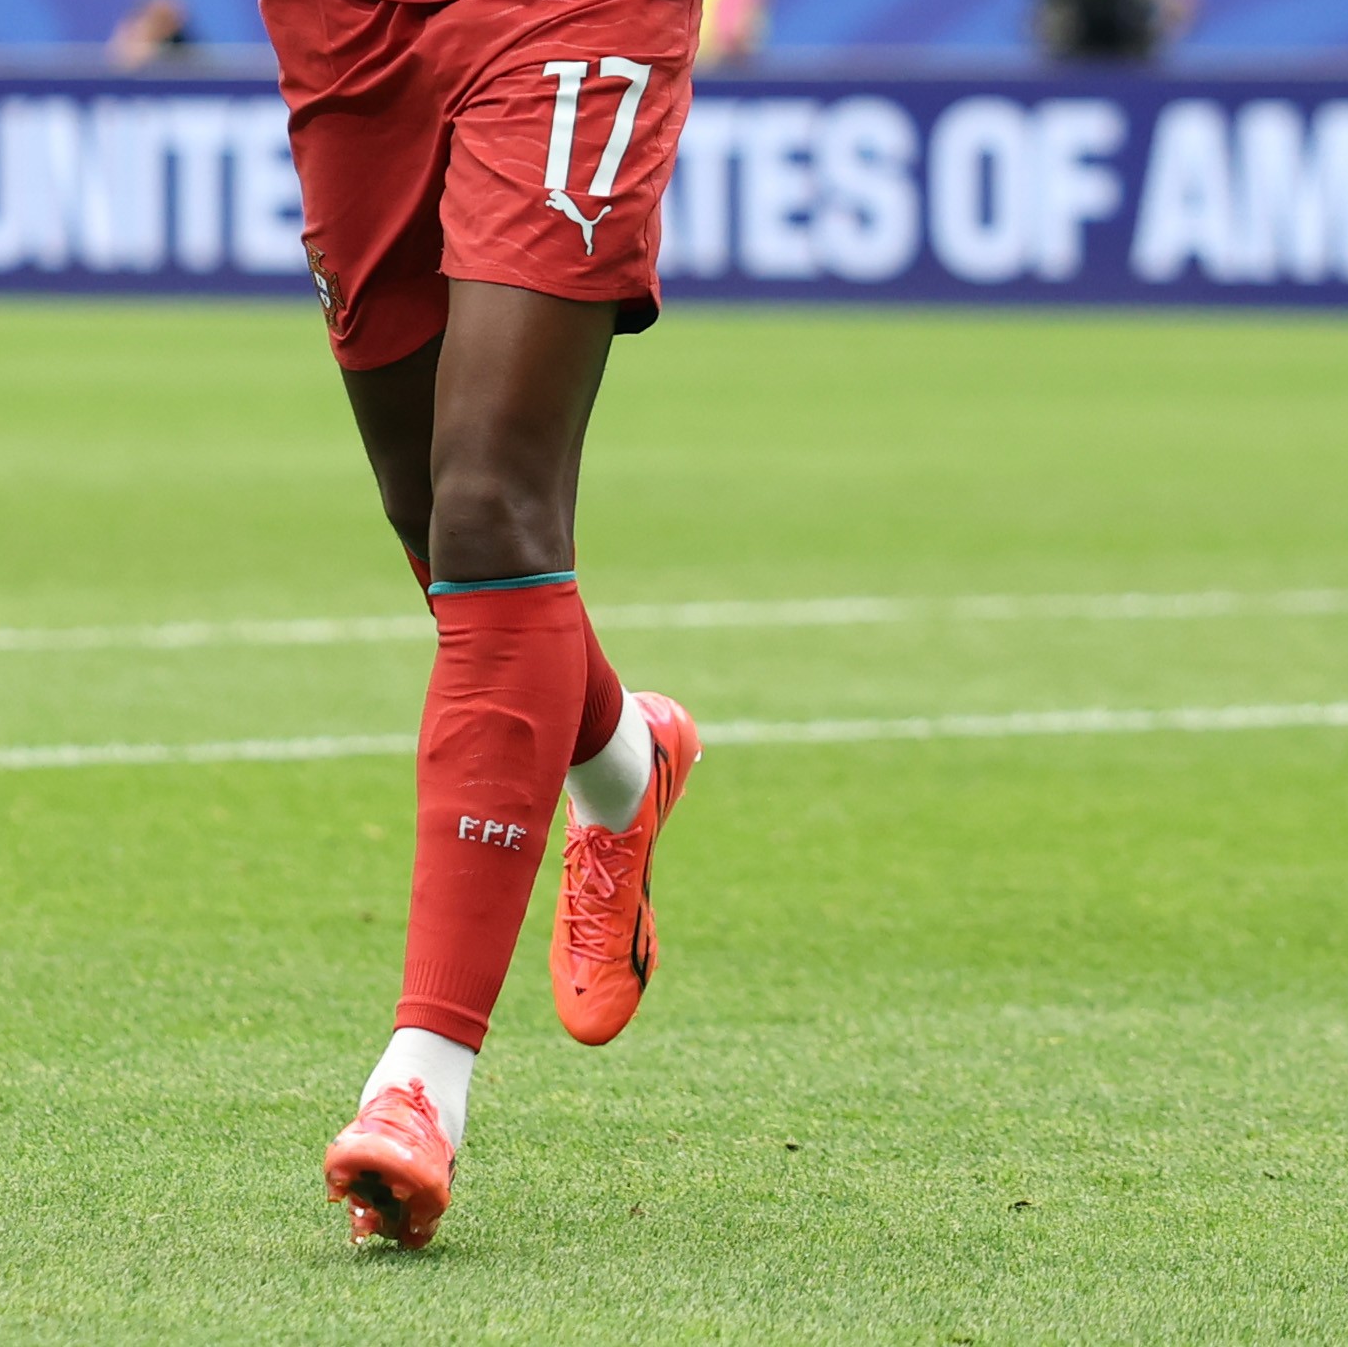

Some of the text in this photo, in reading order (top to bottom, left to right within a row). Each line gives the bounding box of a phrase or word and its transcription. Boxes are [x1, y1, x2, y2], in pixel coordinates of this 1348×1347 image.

[542, 56, 653, 197] 17
[660, 93, 923, 284] TES
[928, 93, 1127, 284] OF
